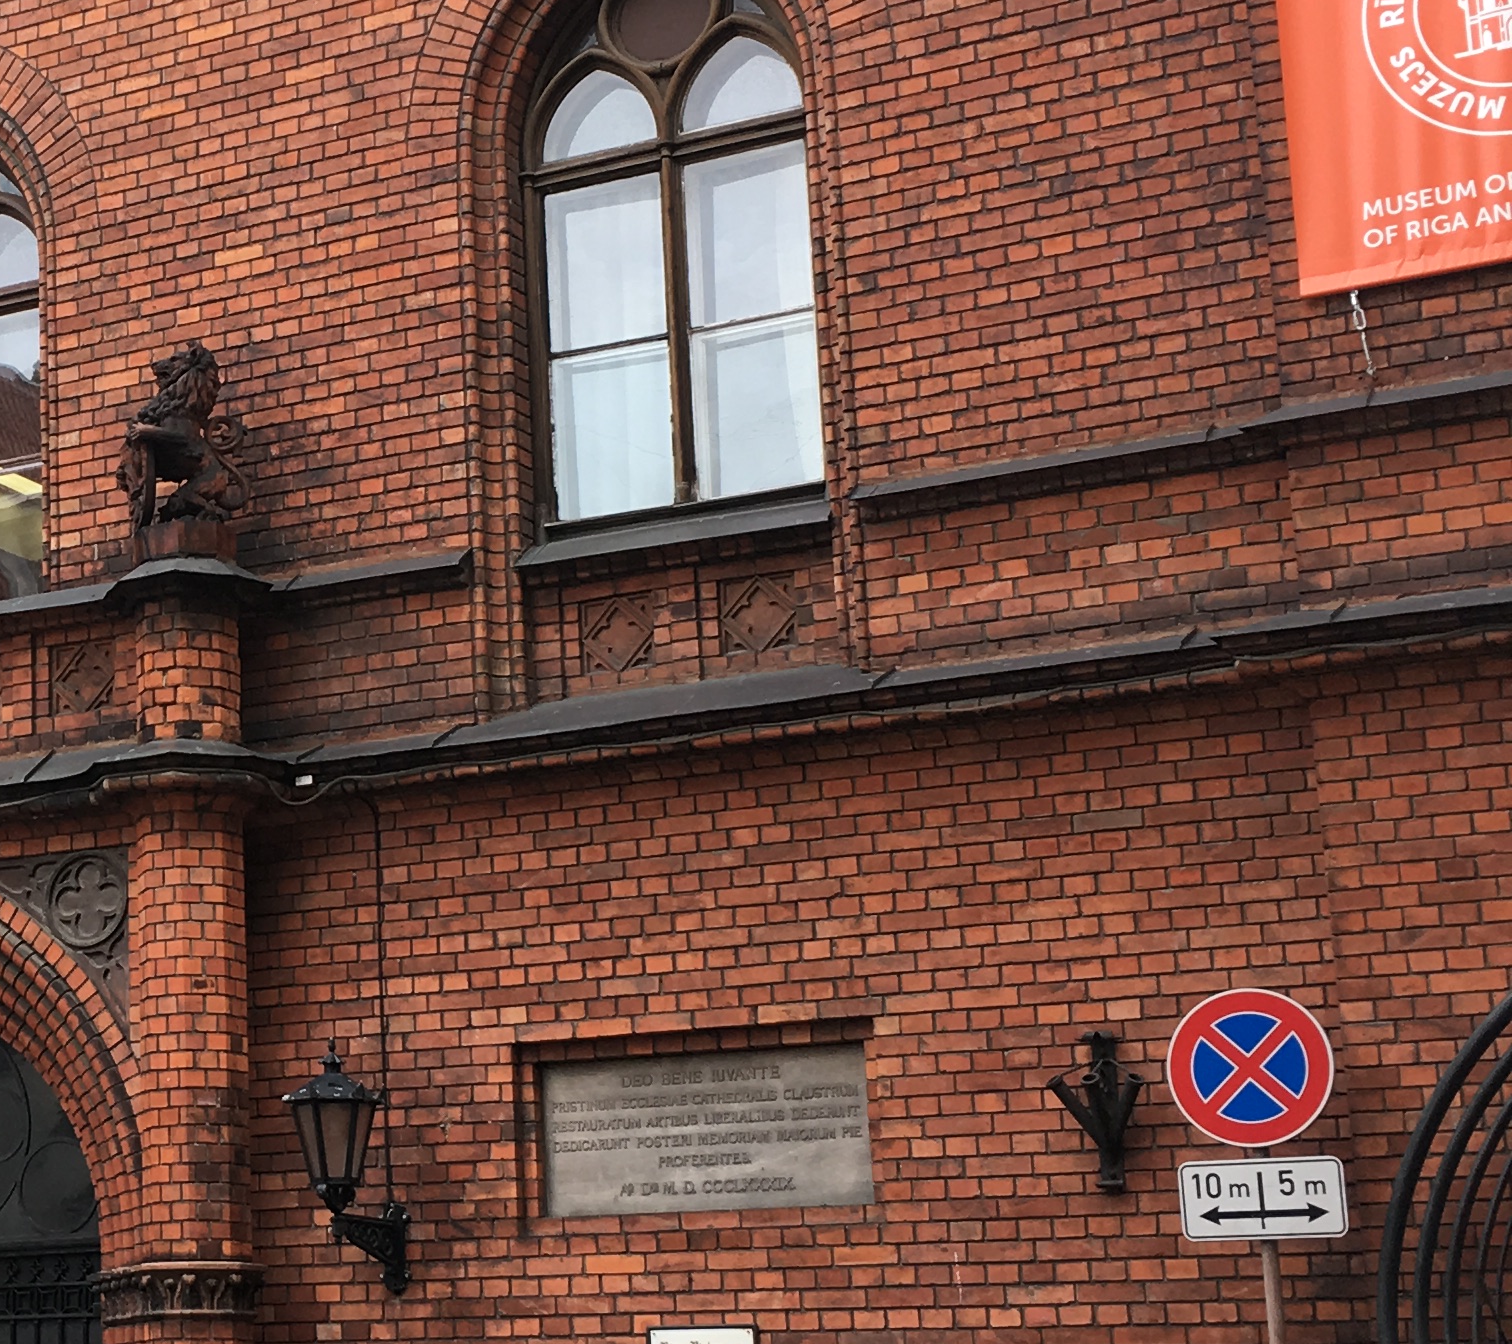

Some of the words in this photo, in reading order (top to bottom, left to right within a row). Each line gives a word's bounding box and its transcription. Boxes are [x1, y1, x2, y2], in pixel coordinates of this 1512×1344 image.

[1389, 46, 1507, 119] MUZEJS
[1363, 179, 1477, 220] MUSEUM
[1363, 224, 1398, 248] OF
[1406, 211, 1469, 241] RIGA
[621, 1074, 653, 1088] DEO
[661, 1071, 703, 1085] BENE
[711, 1065, 781, 1083] IUVANTE
[551, 1101, 616, 1114] PRISTINUM
[621, 1095, 688, 1110] ECCLESIAE
[692, 1090, 778, 1105] CATHEDRALIS
[783, 1084, 859, 1101] CLAUSTRUM
[552, 1118, 642, 1134] RESTAURATUM
[645, 1114, 699, 1129] ARTIBUS
[703, 1109, 785, 1126] LIBERALIBUS
[790, 1105, 861, 1121] DEDERUNT
[552, 1138, 631, 1154] DEDICARUNT
[636, 1134, 692, 1149] POSTERI
[697, 1130, 771, 1146] MEMORIAM
[841, 1126, 863, 1139] PIE
[1191, 1172, 1222, 1199] 10
[1229, 1183, 1251, 1198] m
[1278, 1169, 1296, 1196] 5
[1304, 1179, 1327, 1195] m
